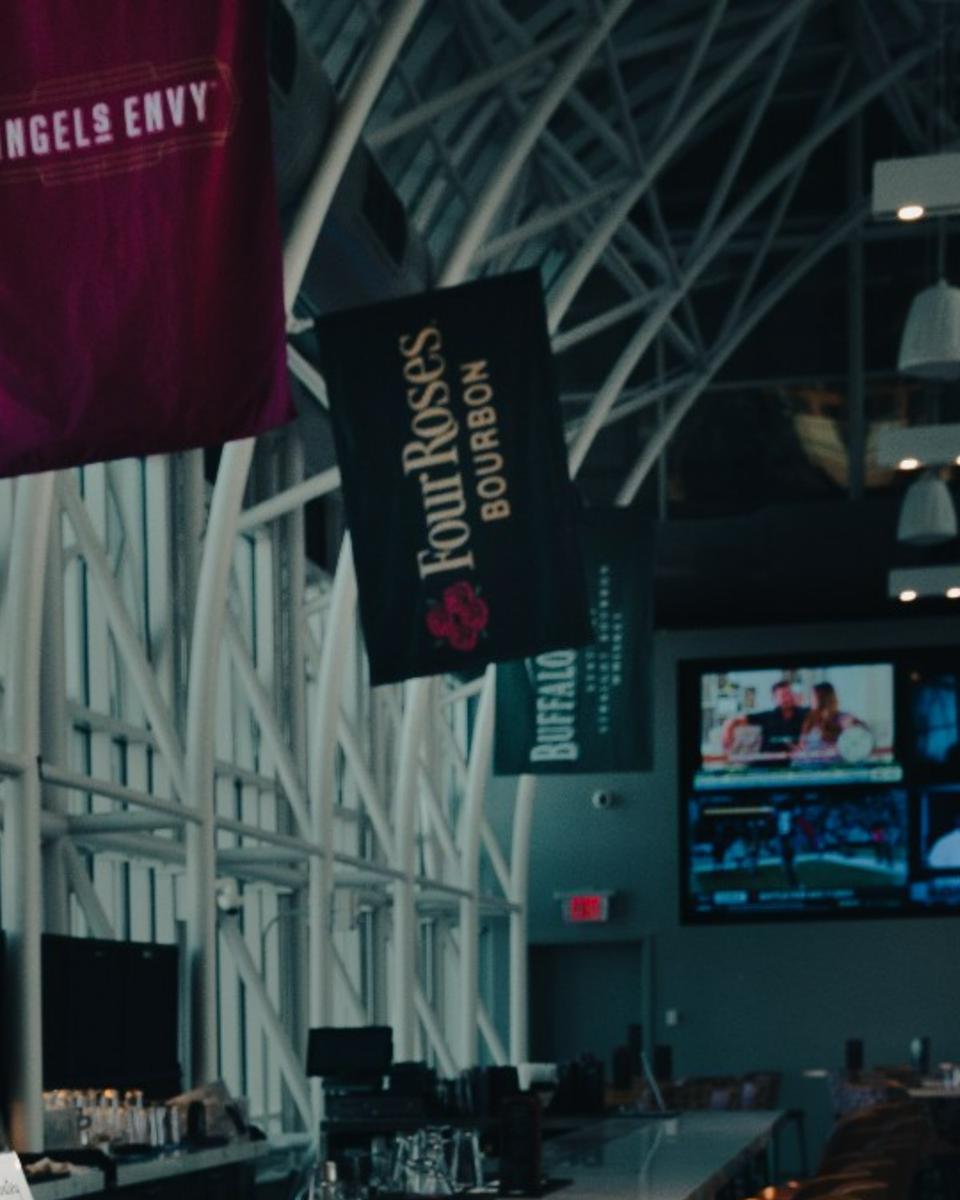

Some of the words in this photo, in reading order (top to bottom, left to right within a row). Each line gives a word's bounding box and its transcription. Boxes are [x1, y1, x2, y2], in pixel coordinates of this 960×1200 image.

[123, 81, 209, 139] ENVY
[398, 324, 459, 476] Roses
[462, 359, 511, 523] BOURBON
[417, 472, 474, 580] Four
[529, 649, 578, 762] BUFFALO
